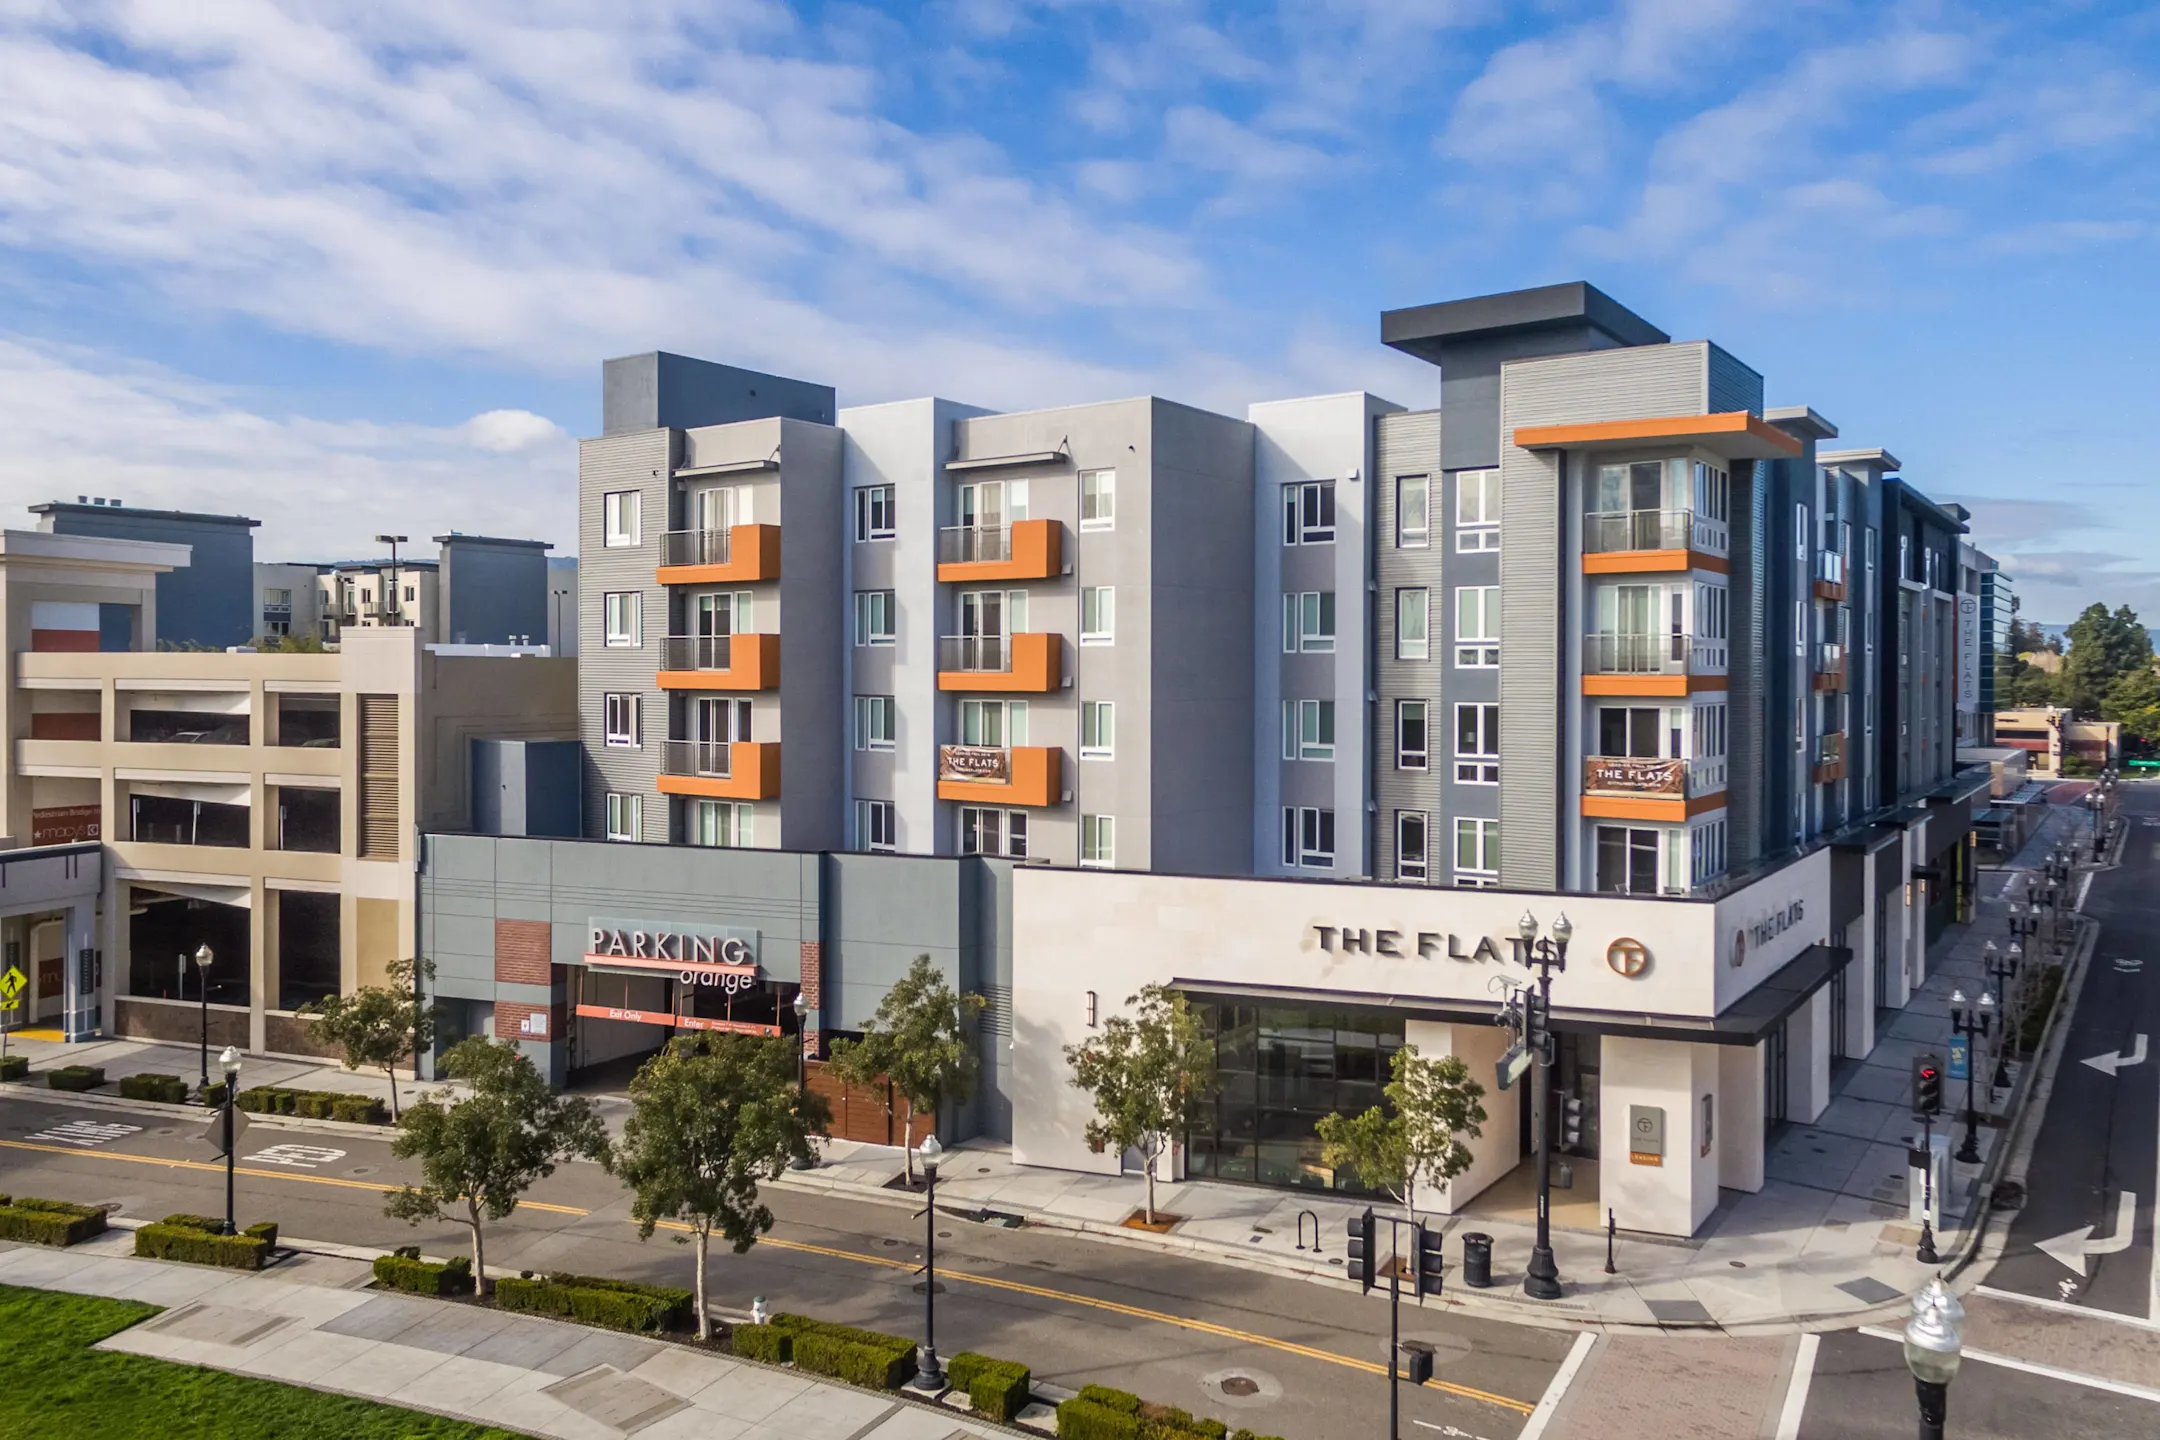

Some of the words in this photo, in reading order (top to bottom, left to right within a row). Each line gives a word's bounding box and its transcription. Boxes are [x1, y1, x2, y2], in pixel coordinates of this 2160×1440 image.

[1964, 620, 1972, 647] THE
[1963, 652, 1973, 699] FLATS
[946, 756, 965, 766] THE
[968, 758, 998, 768] FLATS
[1596, 769, 1623, 779] THE
[1628, 770, 1673, 781] FLATS
[1754, 917, 1775, 949] THE
[1777, 899, 1803, 935] FLATS
[592, 927, 746, 966] PARKING
[1313, 926, 1400, 954] THE
[1418, 932, 1557, 962] FLATS
[680, 970, 752, 995] orange
[610, 1008, 622, 1018] Exit
[624, 1010, 642, 1022] Only
[684, 1017, 705, 1028] Enter
